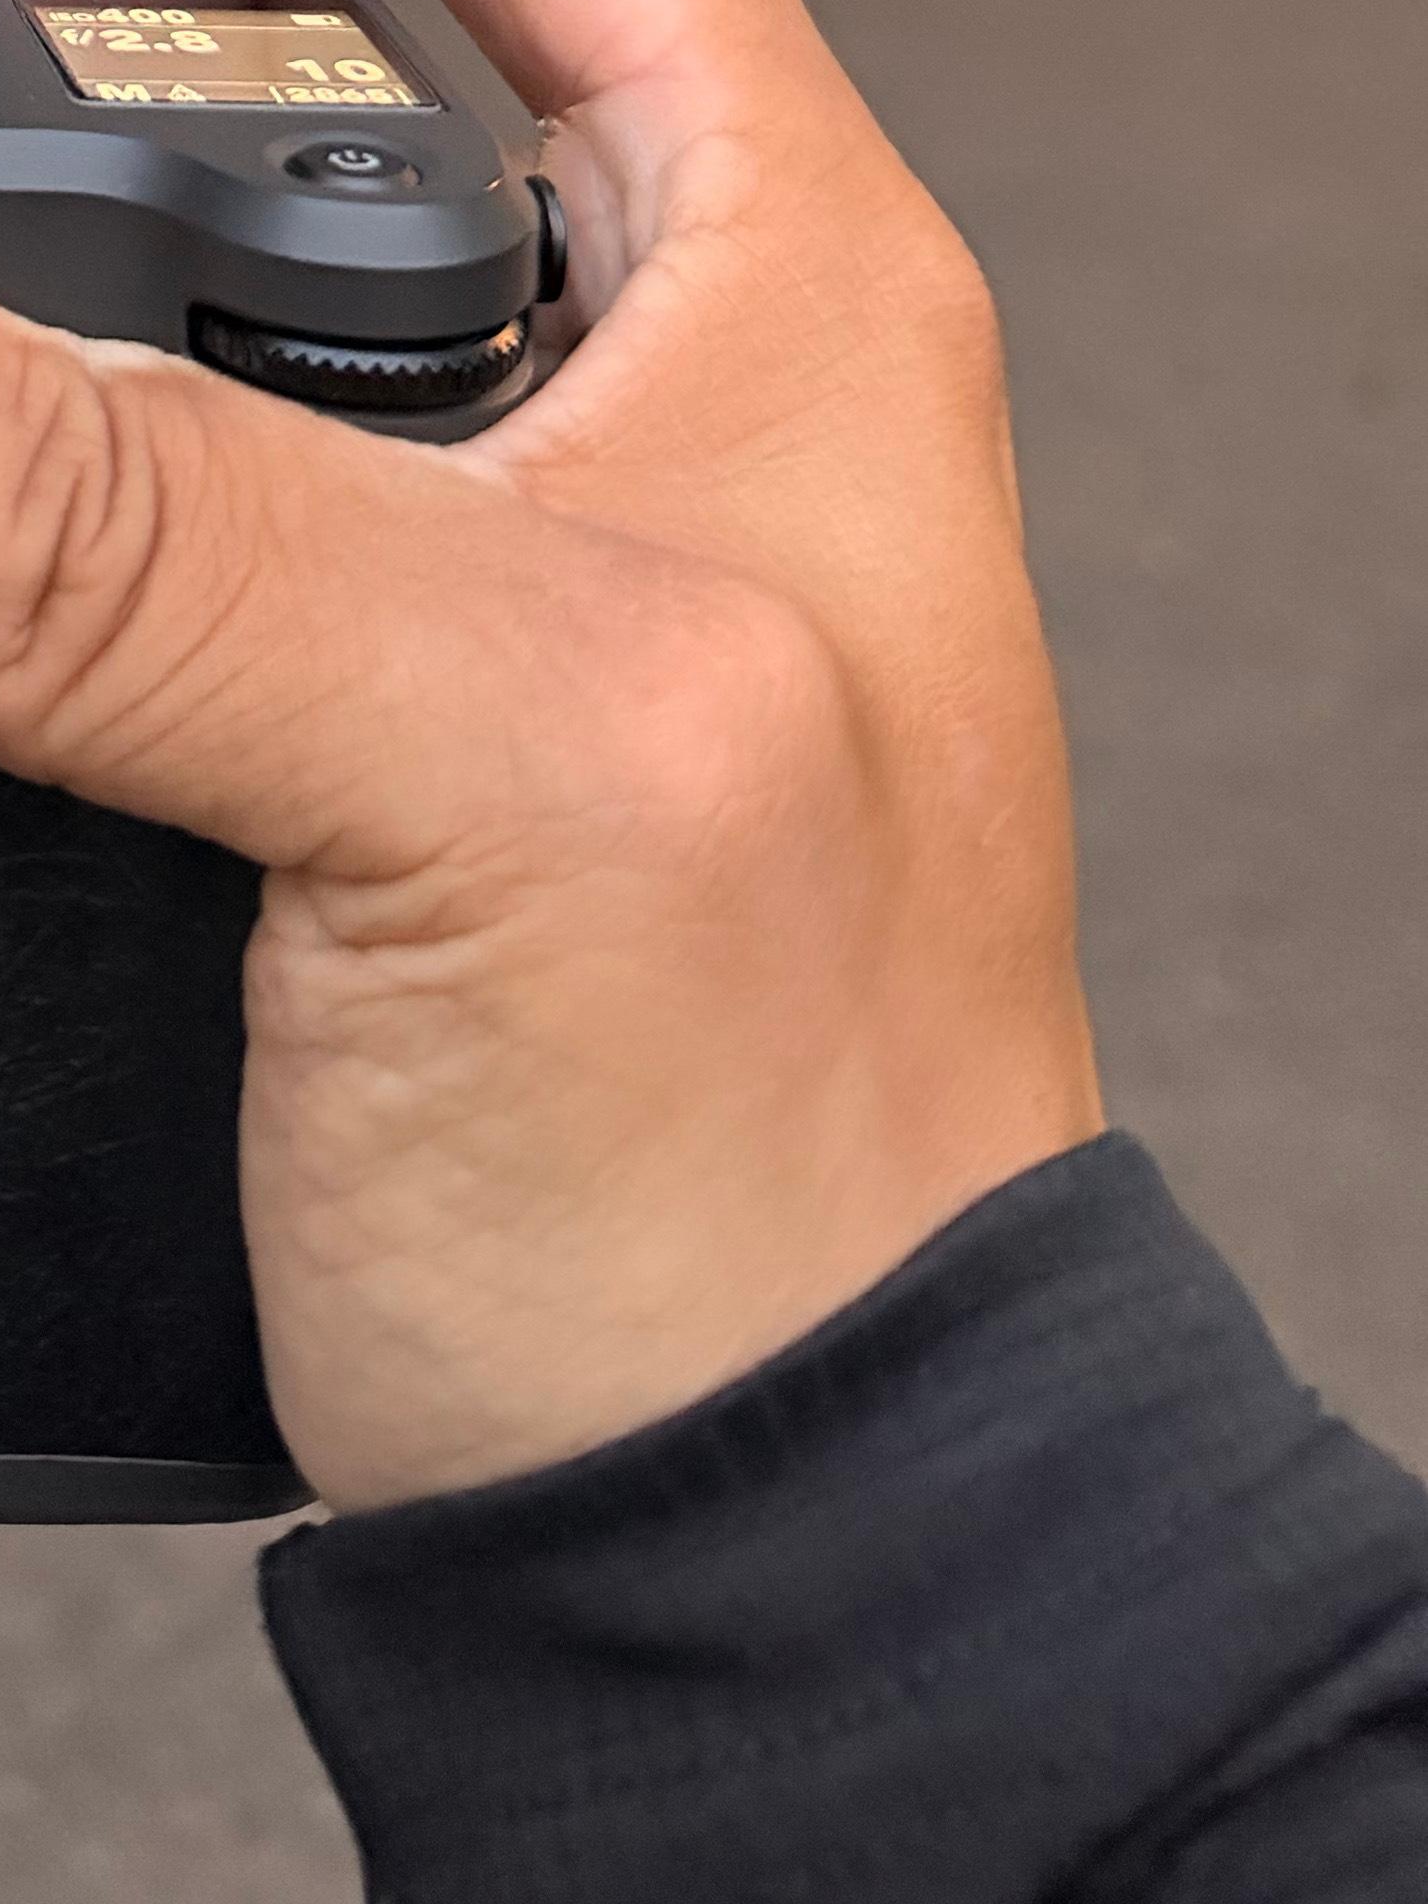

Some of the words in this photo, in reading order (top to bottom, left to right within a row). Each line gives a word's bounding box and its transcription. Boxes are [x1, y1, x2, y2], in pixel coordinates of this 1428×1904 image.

[60, 29, 221, 53] f/2.8
[286, 58, 387, 83] 10
[95, 82, 152, 103] M
